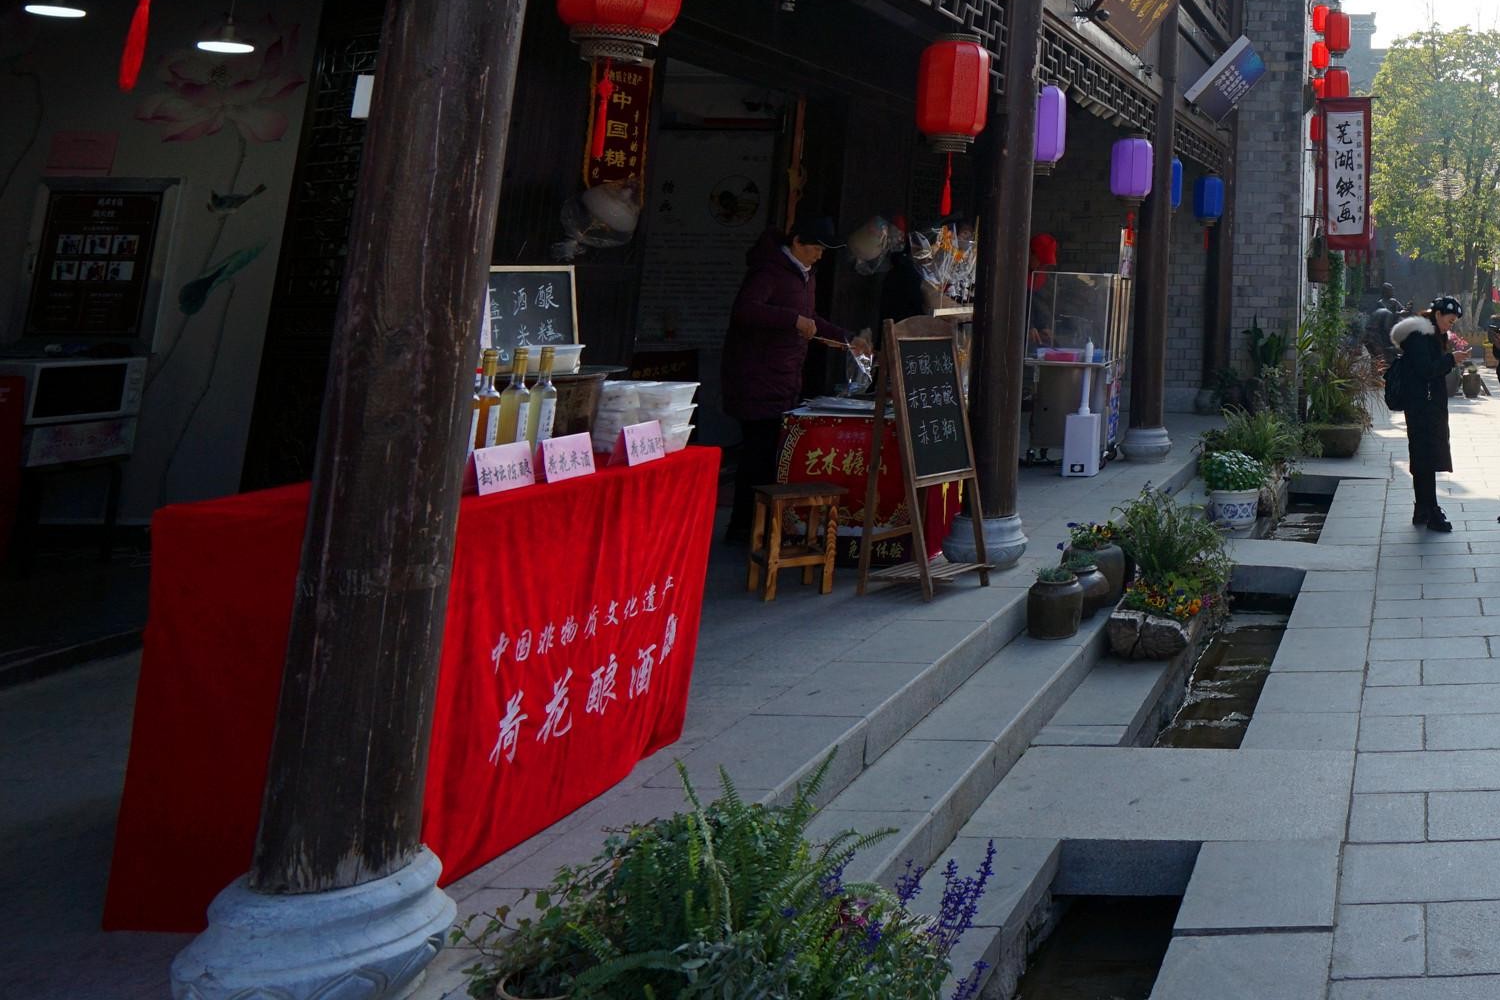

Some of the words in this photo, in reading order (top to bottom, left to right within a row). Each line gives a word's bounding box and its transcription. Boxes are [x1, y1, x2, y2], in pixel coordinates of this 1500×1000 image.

[603, 91, 632, 183] 中国糖
[848, 541, 904, 560] 免体验
[490, 575, 674, 674] 中国非物质文化遗产
